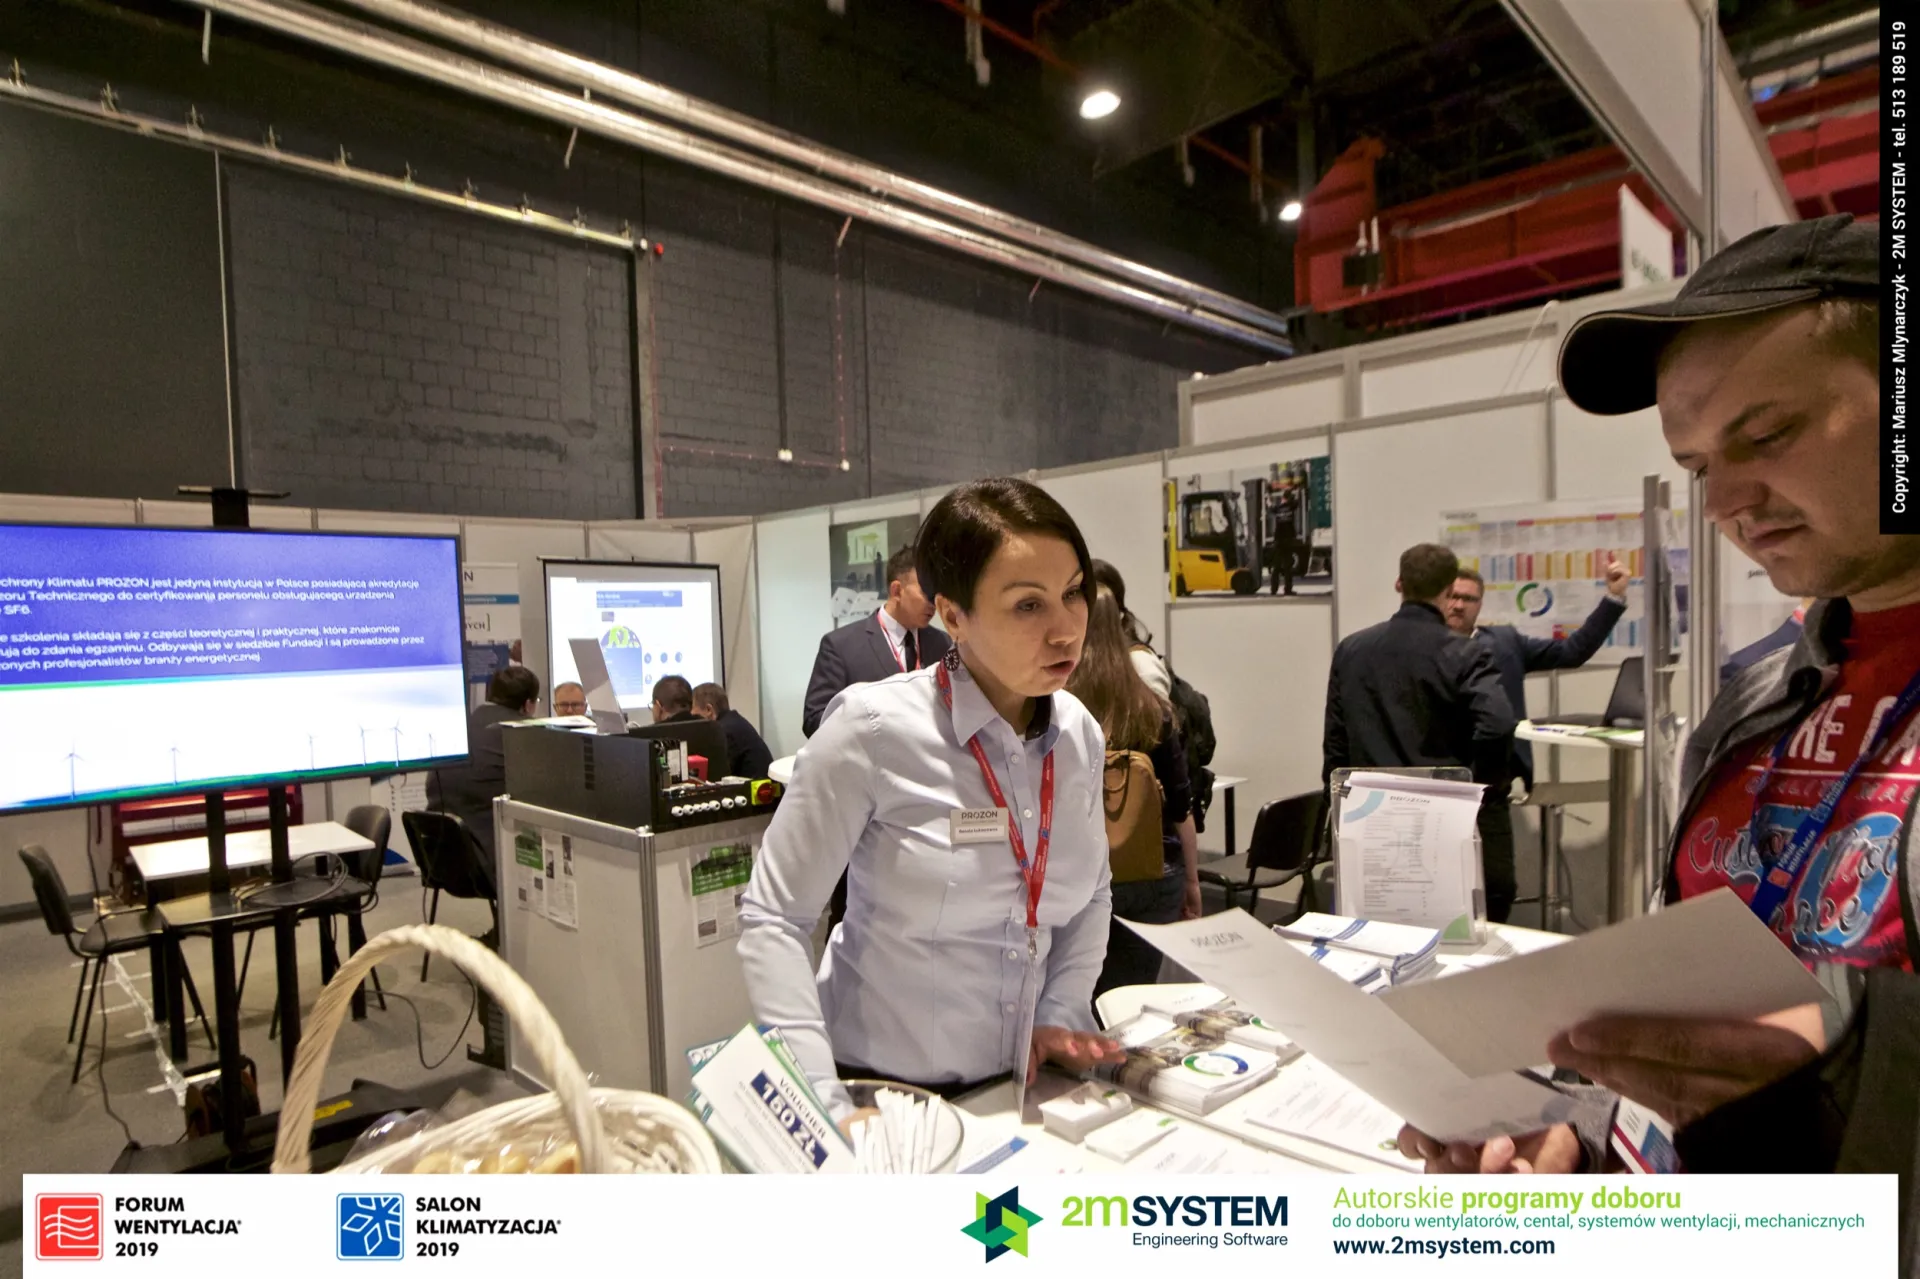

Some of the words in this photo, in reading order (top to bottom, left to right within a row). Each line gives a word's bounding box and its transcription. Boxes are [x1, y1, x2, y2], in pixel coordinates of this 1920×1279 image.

[47, 577, 95, 588] Klimatu
[97, 577, 150, 588] PROZON
[151, 577, 172, 589] jest
[264, 579, 275, 587] w
[276, 578, 310, 589] Polsce
[28, 590, 116, 603] Technicznego
[117, 591, 134, 601] do
[218, 591, 271, 602] personelu
[10, 631, 70, 642] szkolenia
[142, 631, 150, 639] z
[189, 627, 255, 639] teoretycznej
[350, 624, 401, 635] znakomicie
[21, 645, 41, 656] do
[42, 644, 84, 656] zdania
[224, 640, 234, 649] w
[236, 640, 280, 649] siedzibie
[282, 637, 323, 649] Fundacji
[343, 635, 400, 648] prowadzone
[401, 635, 425, 647] przez
[0, 659, 41, 673] onych
[43, 656, 142, 672] profesjonalistów
[961, 810, 998, 820] PROZON
[762, 1082, 796, 1129] 150
[778, 1077, 827, 1139] VOUCHER
